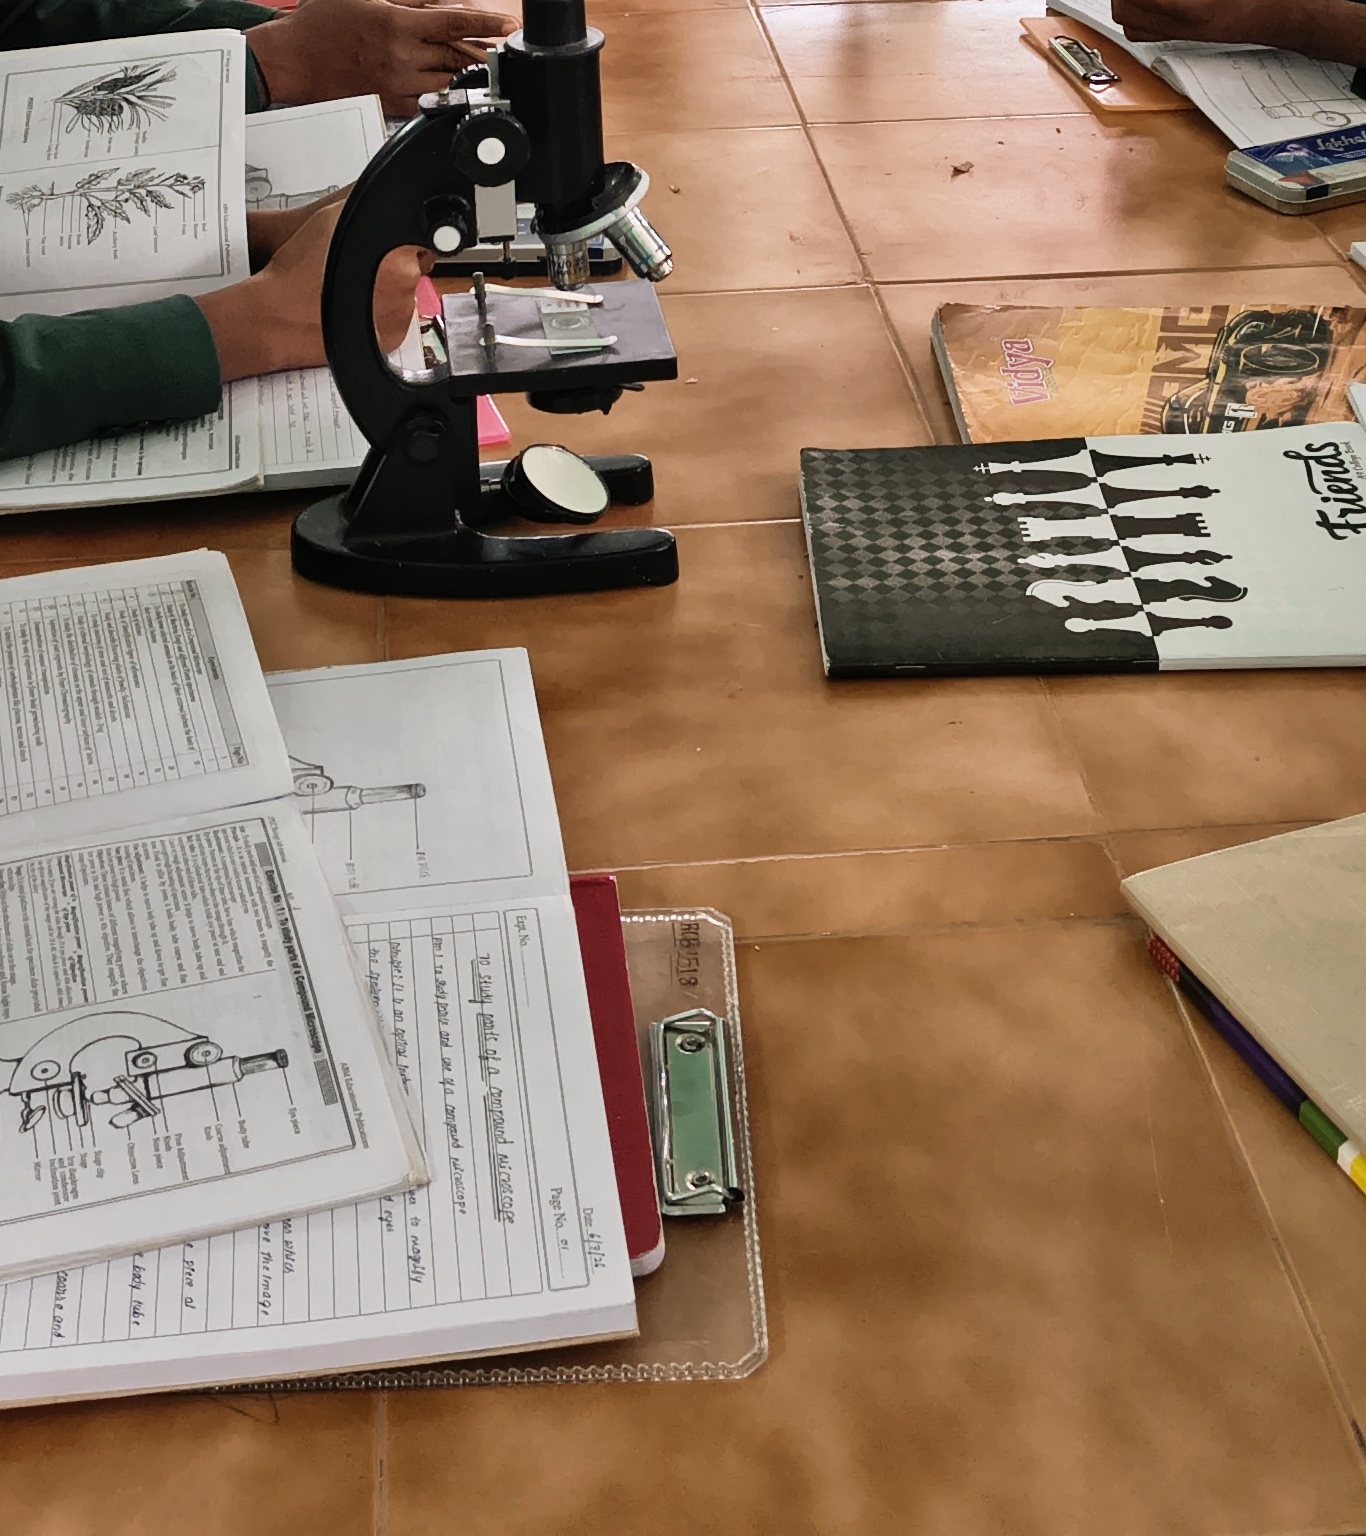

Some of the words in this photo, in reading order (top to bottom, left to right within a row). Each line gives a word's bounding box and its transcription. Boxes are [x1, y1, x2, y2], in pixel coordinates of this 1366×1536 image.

[1000, 338, 1055, 406] Vidya
[292, 975, 313, 1012] Compound
[466, 971, 494, 1005] study
[302, 1012, 324, 1054] Microscope
[547, 1187, 564, 1206] Page
[283, 1238, 295, 1274] which
